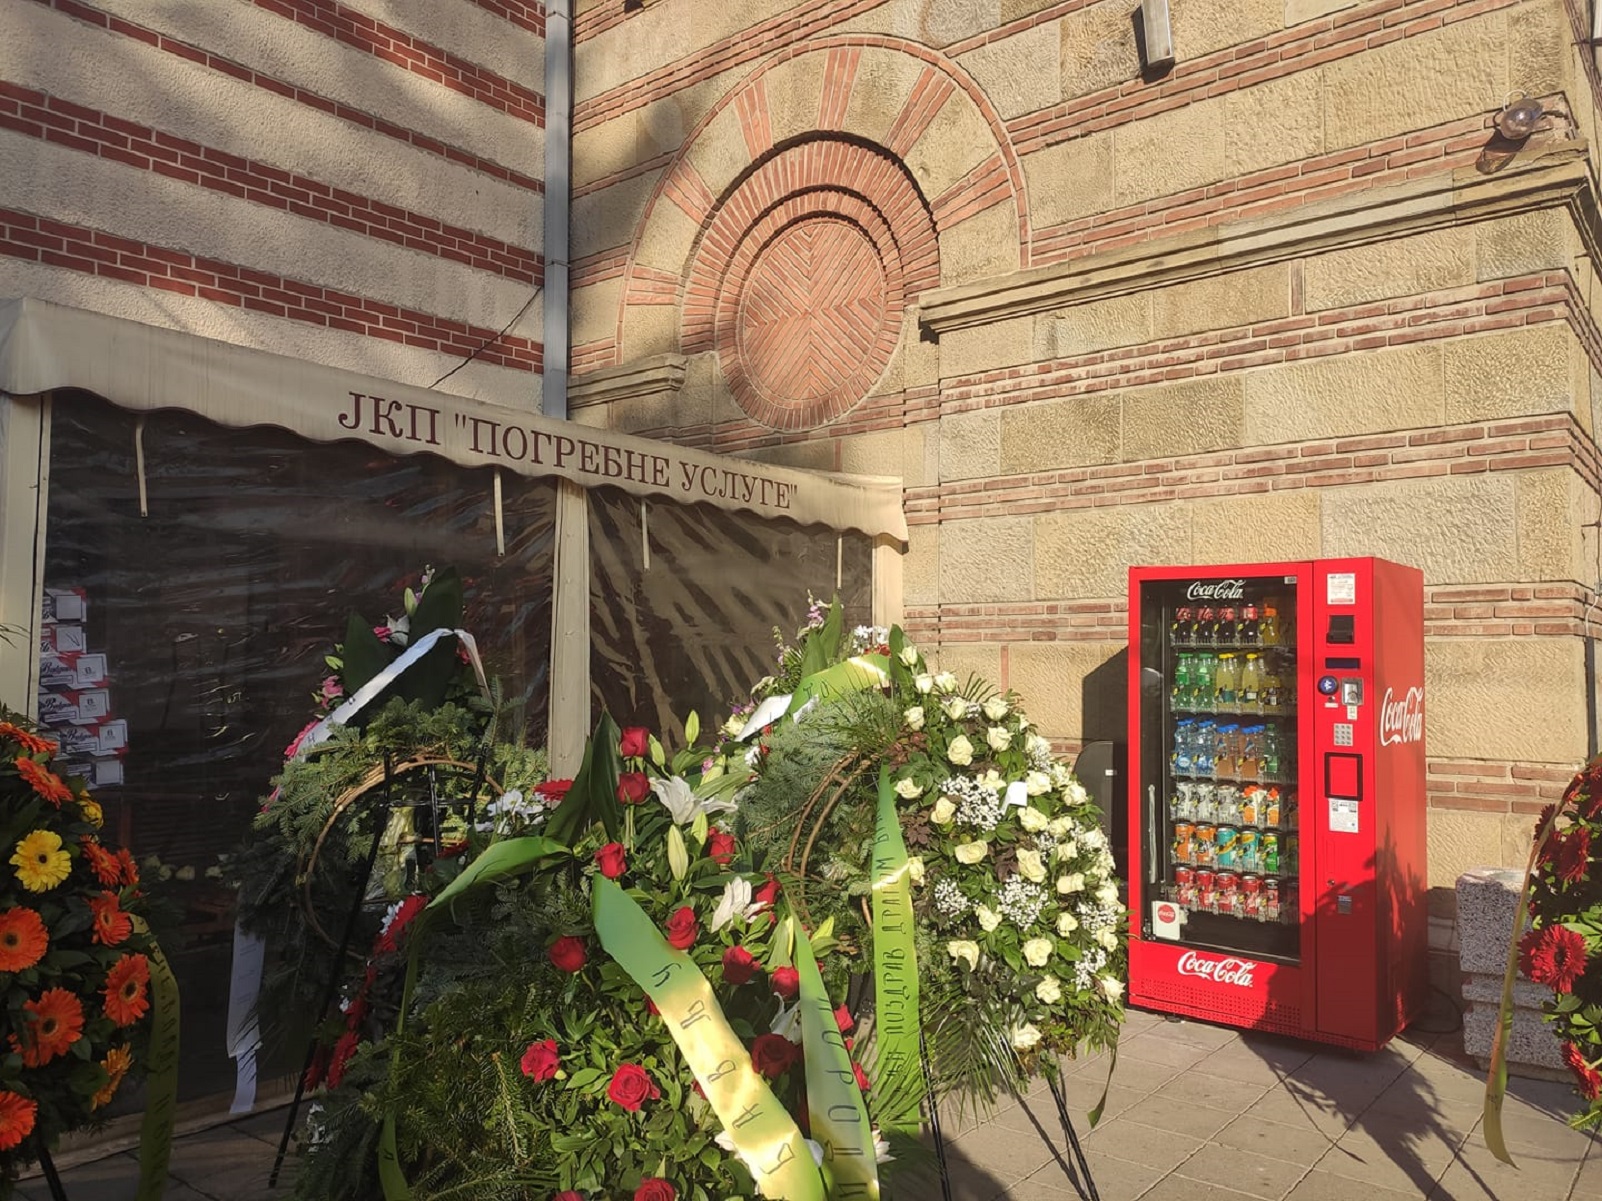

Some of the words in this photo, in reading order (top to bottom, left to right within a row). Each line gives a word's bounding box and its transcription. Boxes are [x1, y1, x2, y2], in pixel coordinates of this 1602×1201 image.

[338, 391, 441, 446] ЈКП
[454, 412, 670, 489] "ПОГРЕБНЕ
[678, 460, 798, 511] УСЛУГЕ"
[1177, 950, 1257, 988] Coca-Cola
